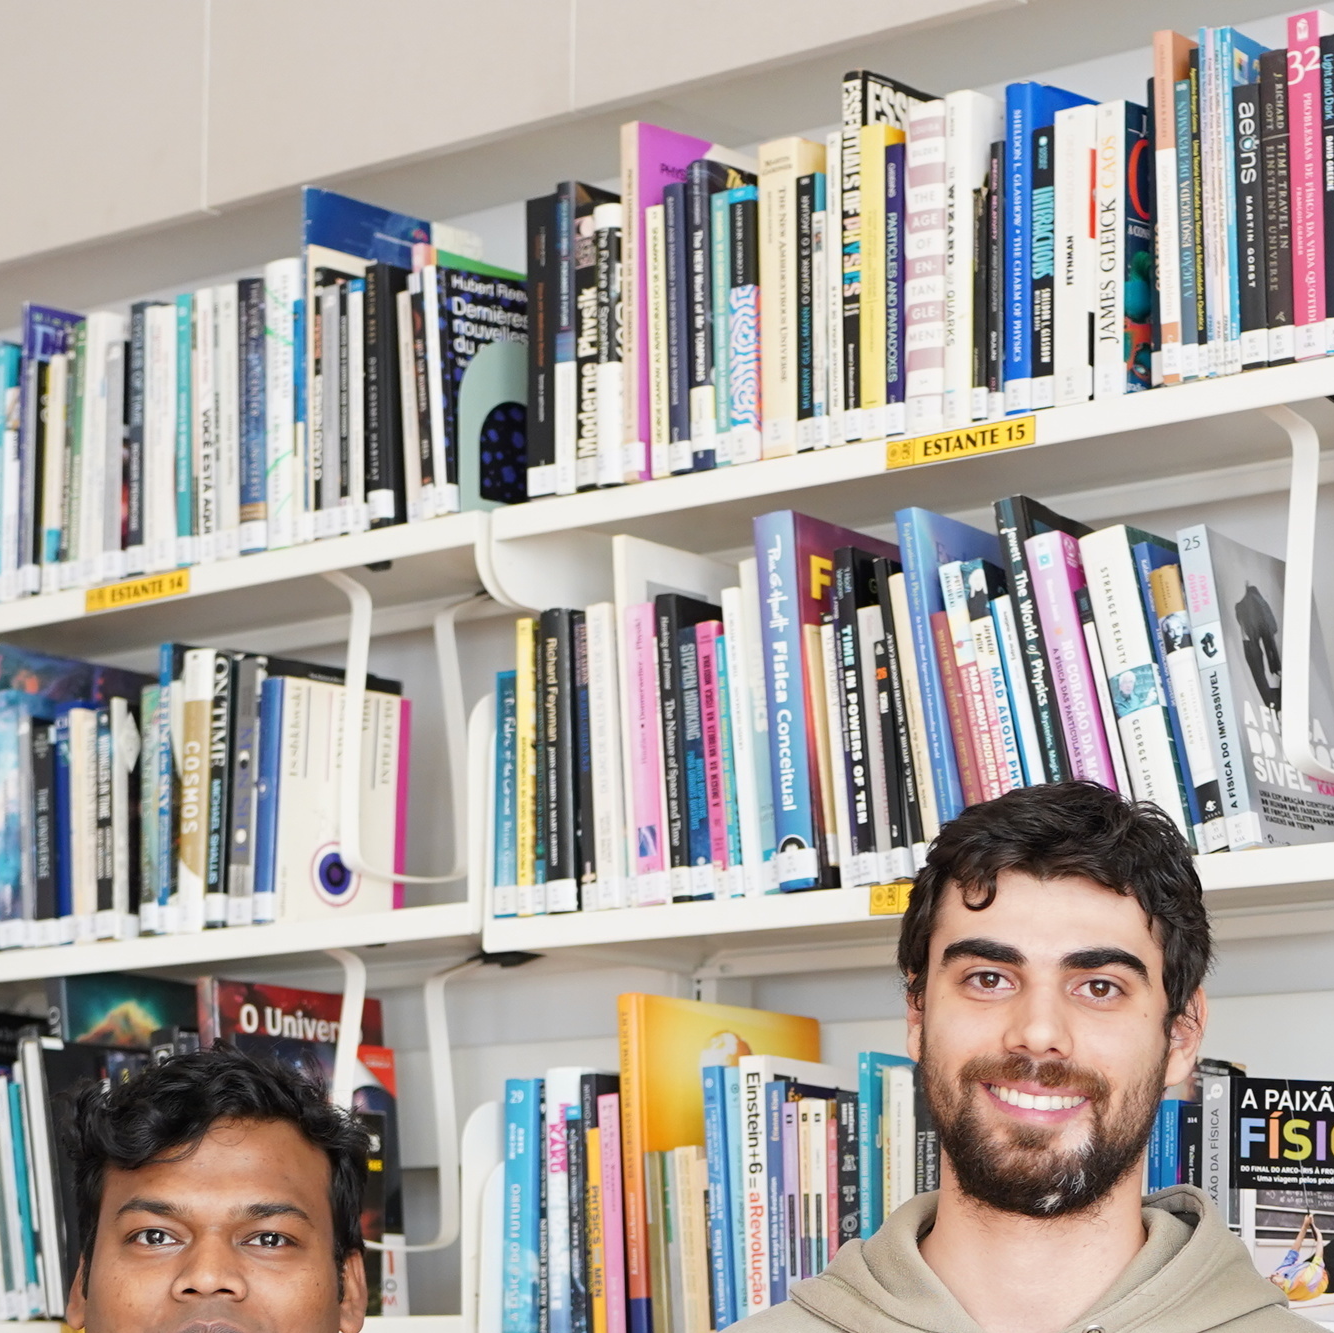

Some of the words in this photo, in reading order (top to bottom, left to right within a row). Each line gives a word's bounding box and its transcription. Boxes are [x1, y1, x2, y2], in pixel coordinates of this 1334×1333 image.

[1287, 46, 1321, 86] 32
[1100, 198, 1117, 272] GLEICK
[1246, 195, 1255, 241] MARTIN
[1247, 248, 1255, 288] GORST
[577, 286, 598, 359] Physik
[1099, 274, 1119, 344] JAMES
[577, 363, 598, 458] Moderne
[923, 427, 999, 457] ESTANTE
[1006, 422, 1025, 440] 15
[1183, 536, 1200, 551] 25
[111, 579, 166, 603] ESTANTE
[168, 576, 184, 591] 14
[1013, 570, 1027, 596] The
[1020, 598, 1038, 644] World
[1100, 567, 1117, 618] STRANGE
[1111, 622, 1127, 665] BEAUTY
[546, 637, 558, 685] Richard
[1027, 656, 1048, 708] Physics
[840, 623, 854, 667] TIME
[847, 691, 863, 761] POWERS
[856, 793, 867, 825] TEN
[1210, 671, 1229, 738] IMPOSSÍVEL
[776, 709, 797, 812] Conceitual
[1221, 739, 1229, 759] DO
[180, 741, 201, 835] COSMOS
[240, 1003, 259, 1033] O
[1241, 1089, 1259, 1110] A
